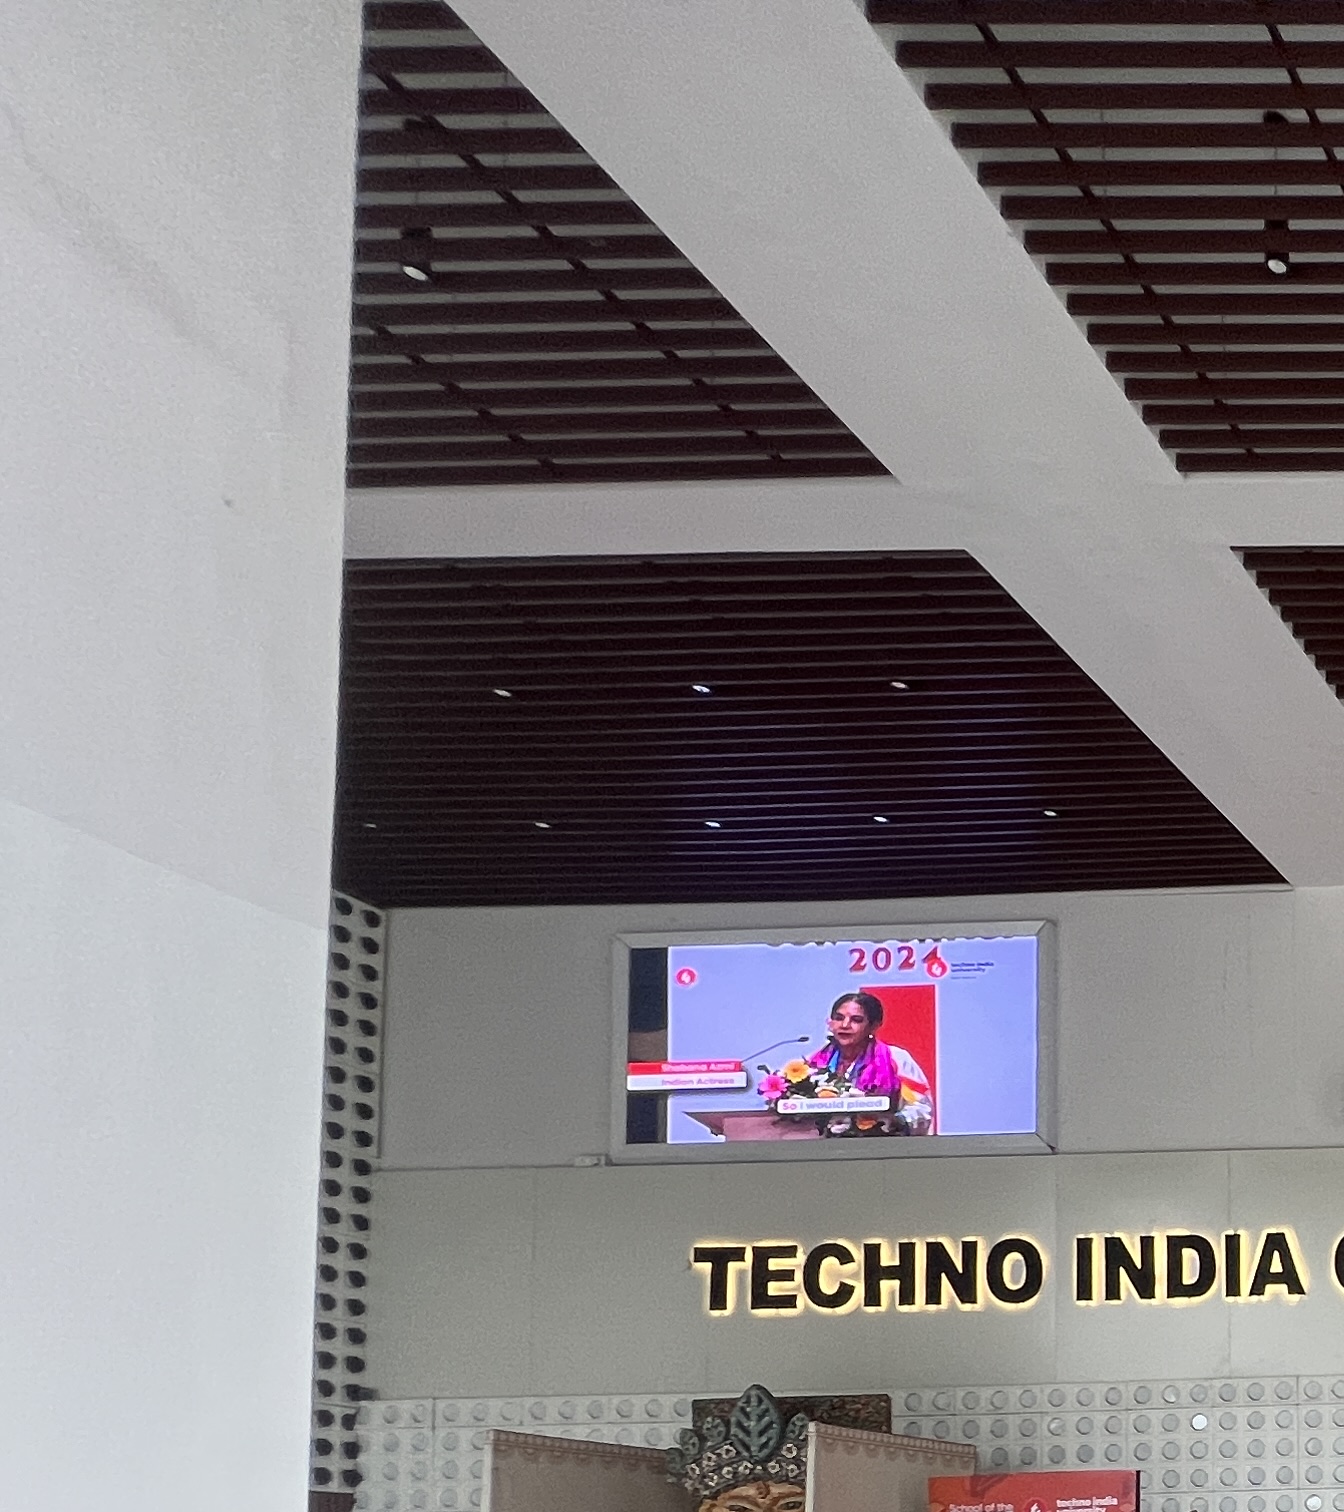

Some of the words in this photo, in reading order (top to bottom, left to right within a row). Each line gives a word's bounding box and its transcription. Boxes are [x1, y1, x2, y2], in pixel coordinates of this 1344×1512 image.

[661, 1078, 694, 1087] Indian
[696, 1077, 735, 1086] Actress
[782, 1100, 797, 1111] So
[806, 1099, 844, 1110] would
[694, 1238, 1043, 1311] TECHNO
[1076, 1232, 1306, 1301] INDIA
[949, 1503, 983, 1512] School
[984, 1502, 995, 1512] of
[996, 1503, 1014, 1512] the
